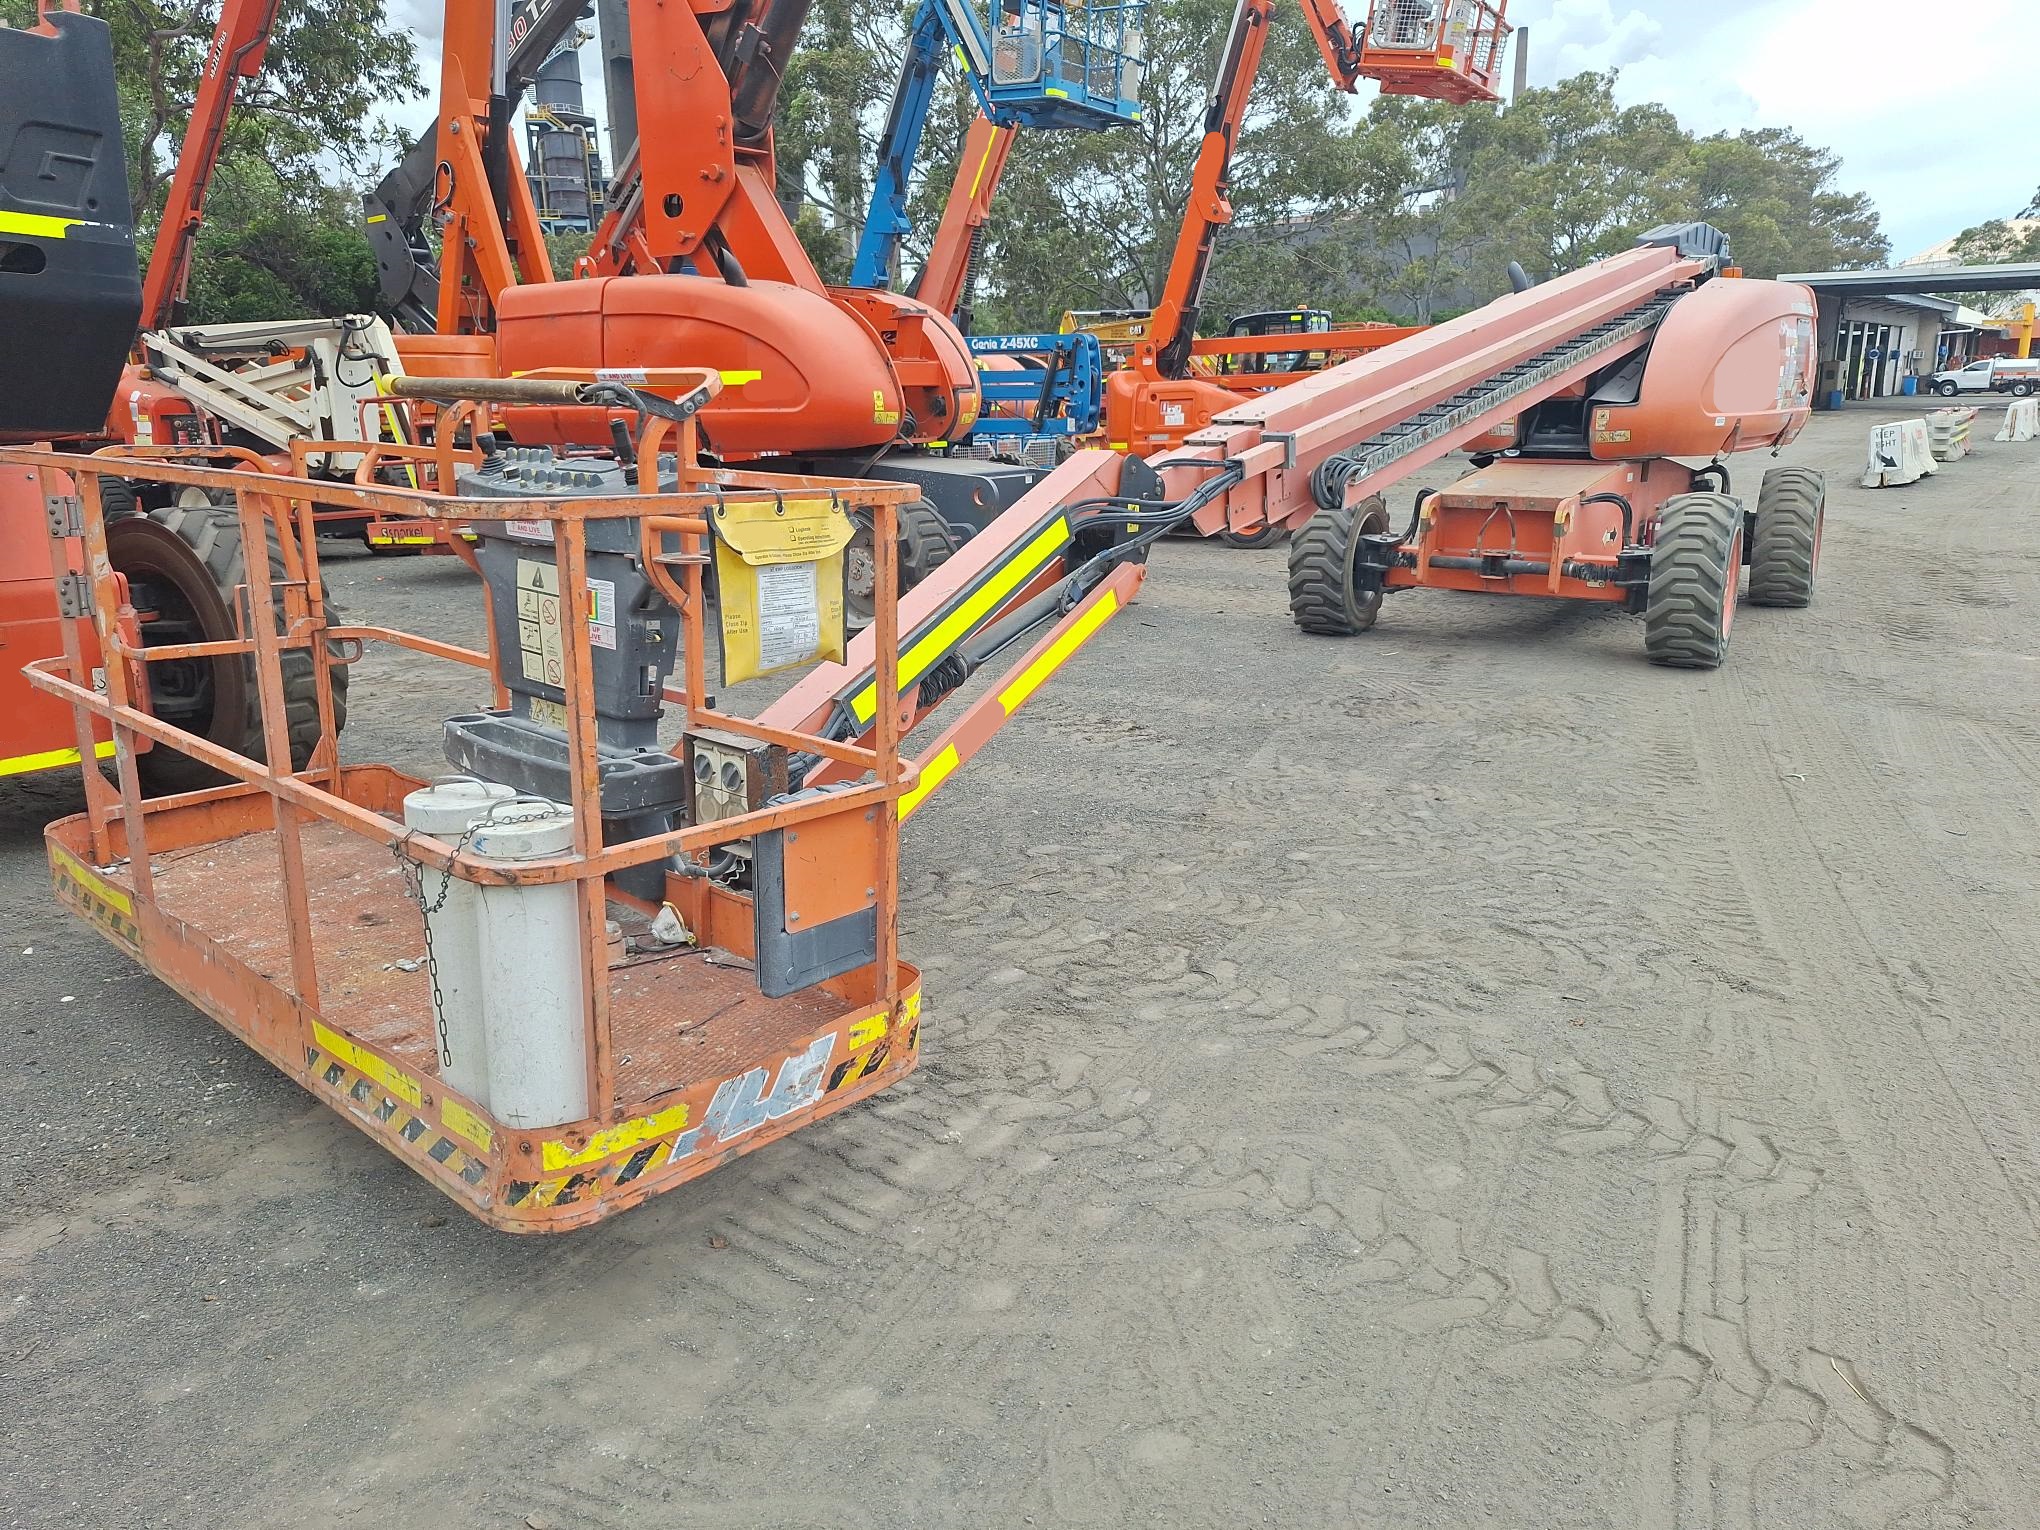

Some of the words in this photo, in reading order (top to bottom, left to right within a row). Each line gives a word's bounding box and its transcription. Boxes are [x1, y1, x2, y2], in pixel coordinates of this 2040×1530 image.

[217, 30, 228, 51] Plus
[1129, 325, 1142, 336] CAT
[971, 338, 998, 350] Genie
[1000, 336, 1039, 349] Z-45XC
[1875, 430, 1895, 439] KEP
[1875, 439, 1897, 449] RGHT
[529, 526, 541, 535] LIVE
